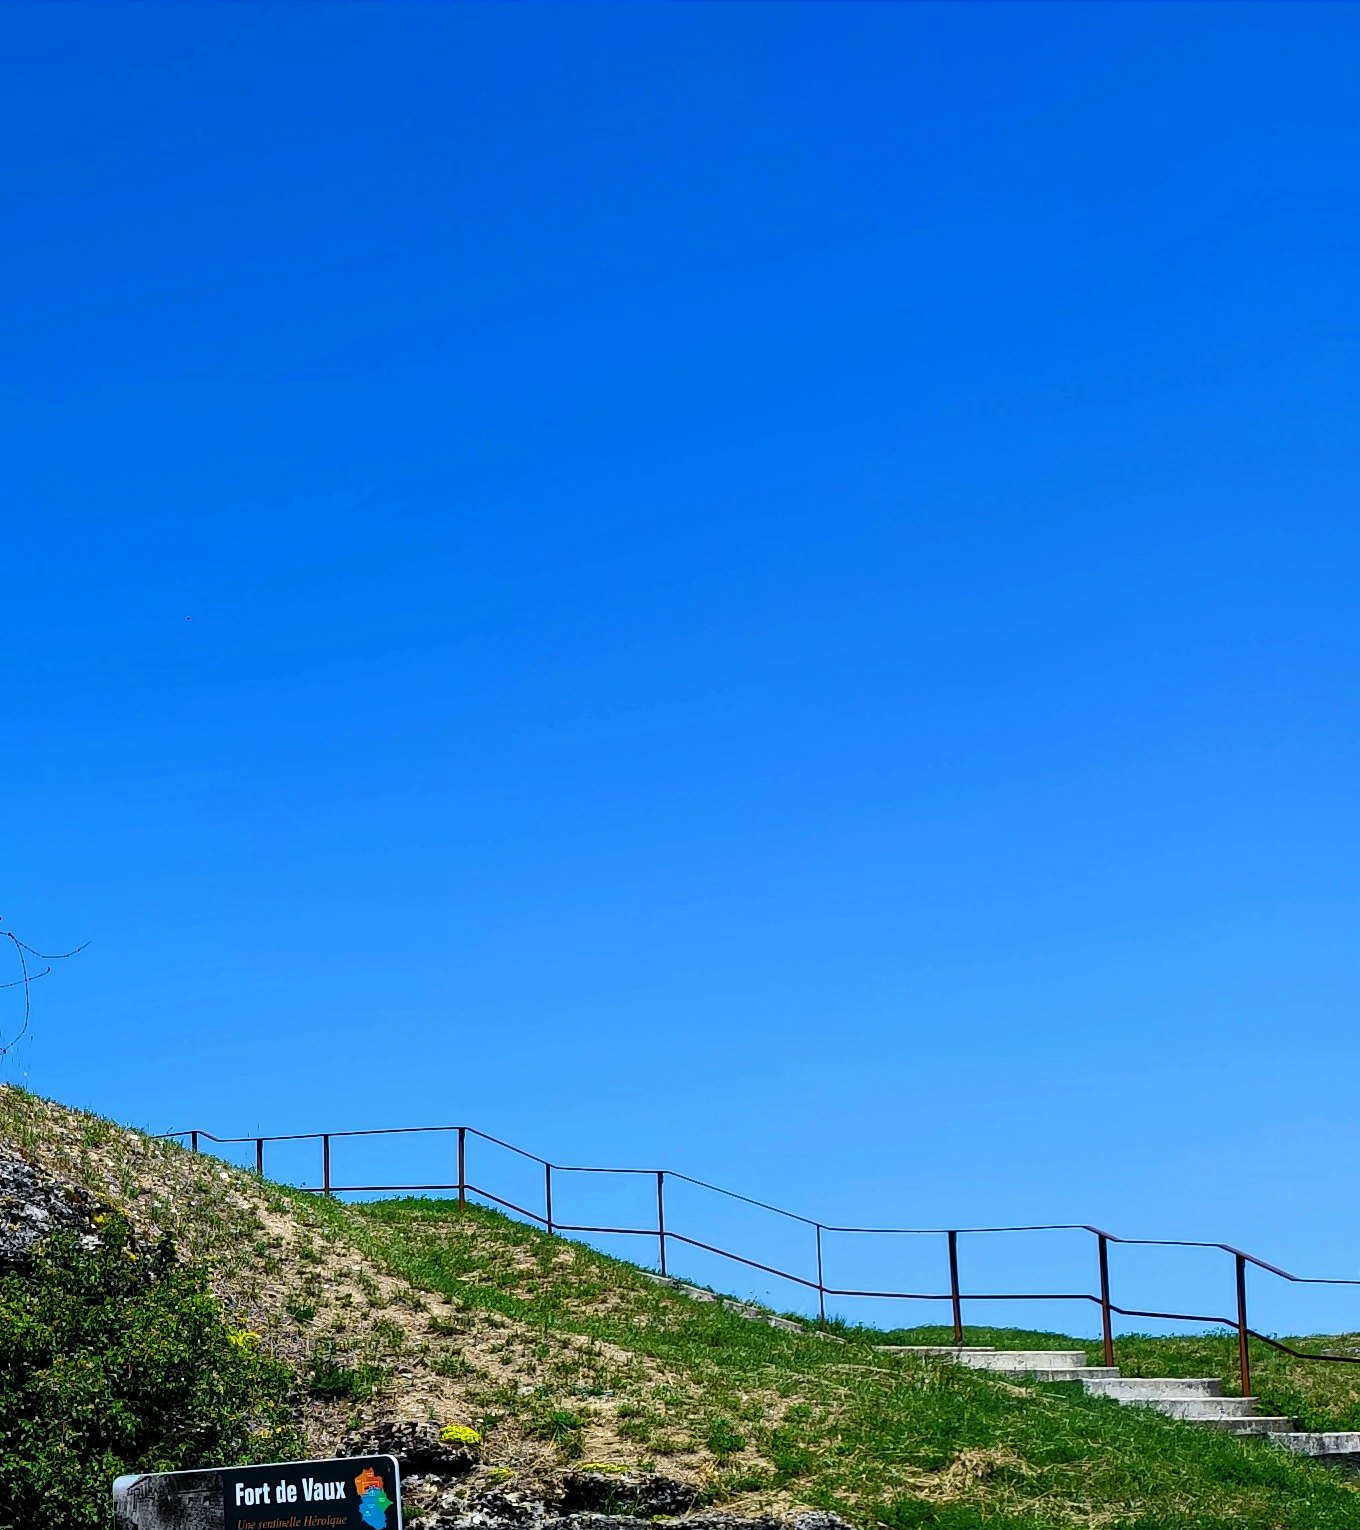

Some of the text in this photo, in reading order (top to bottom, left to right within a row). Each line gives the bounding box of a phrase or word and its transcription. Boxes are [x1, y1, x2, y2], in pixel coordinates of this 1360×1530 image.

[235, 1478, 346, 1506] Fort de Vaux
[238, 1515, 347, 1530] Une sentinelle Héroïque
